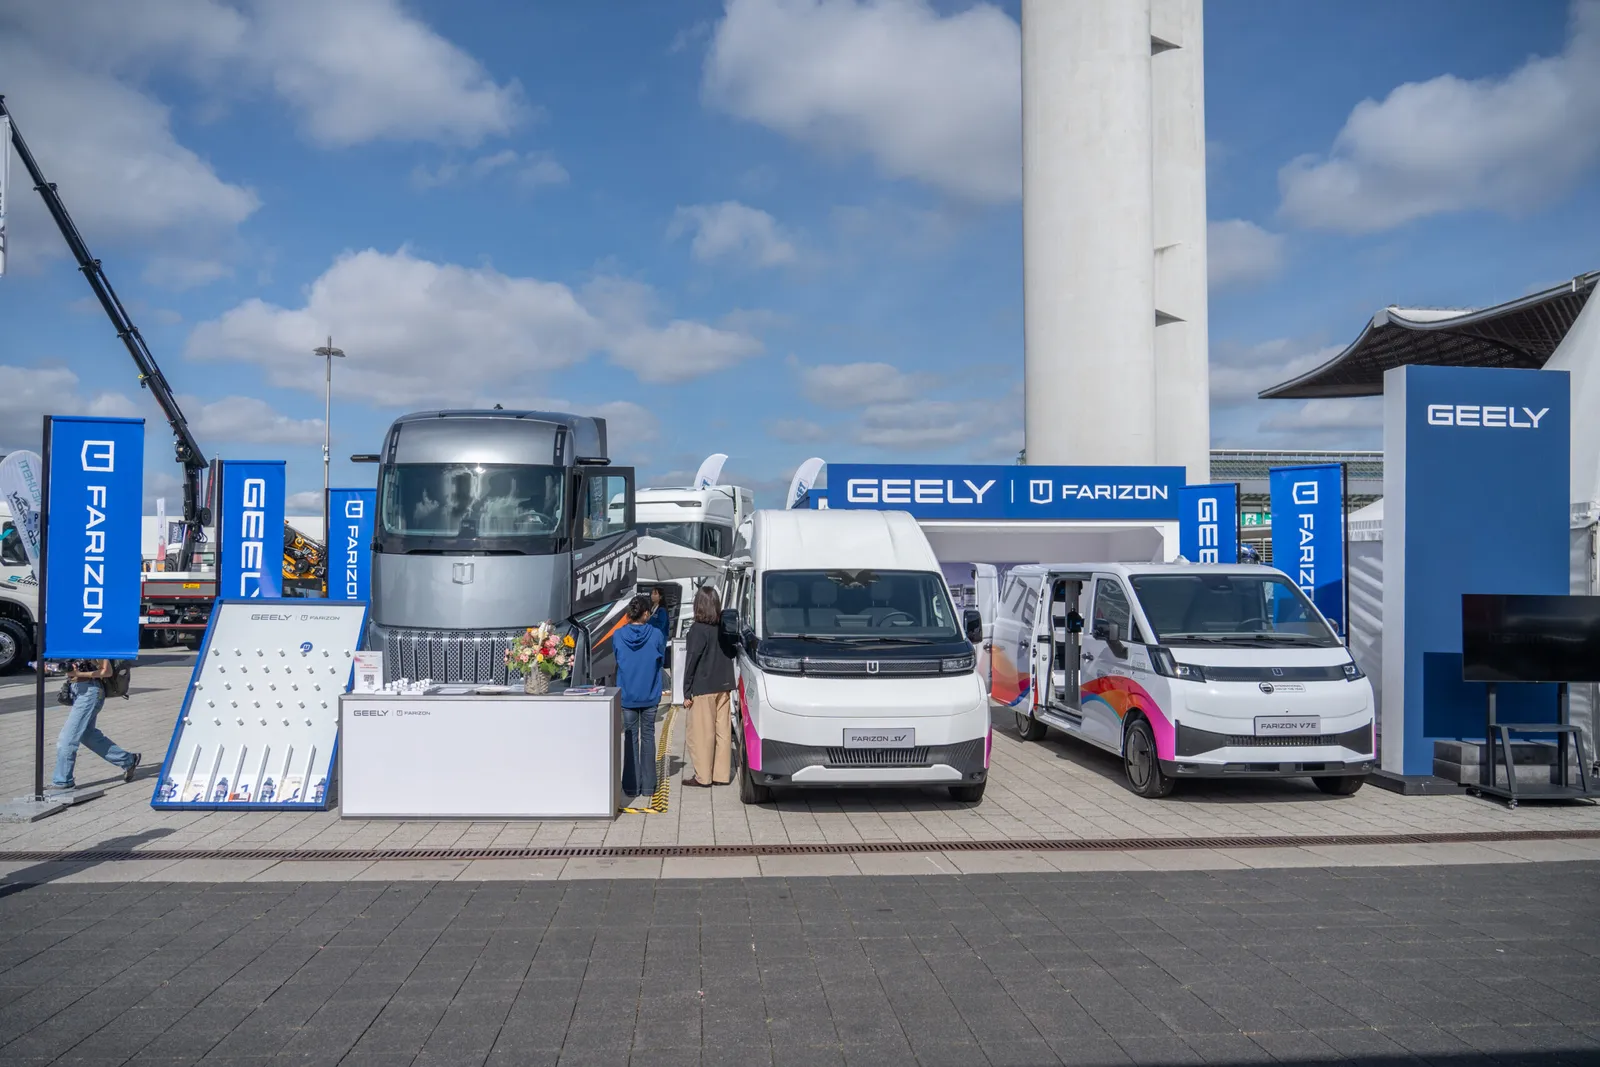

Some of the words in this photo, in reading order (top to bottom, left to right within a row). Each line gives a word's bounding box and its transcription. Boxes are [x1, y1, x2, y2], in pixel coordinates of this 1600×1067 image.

[1427, 404, 1550, 428] GEELY
[846, 478, 996, 505] GEELY
[1062, 484, 1169, 500] FARIZON
[82, 485, 107, 634] FARIZON
[250, 613, 293, 621] GEELY
[353, 709, 389, 717] GEELY
